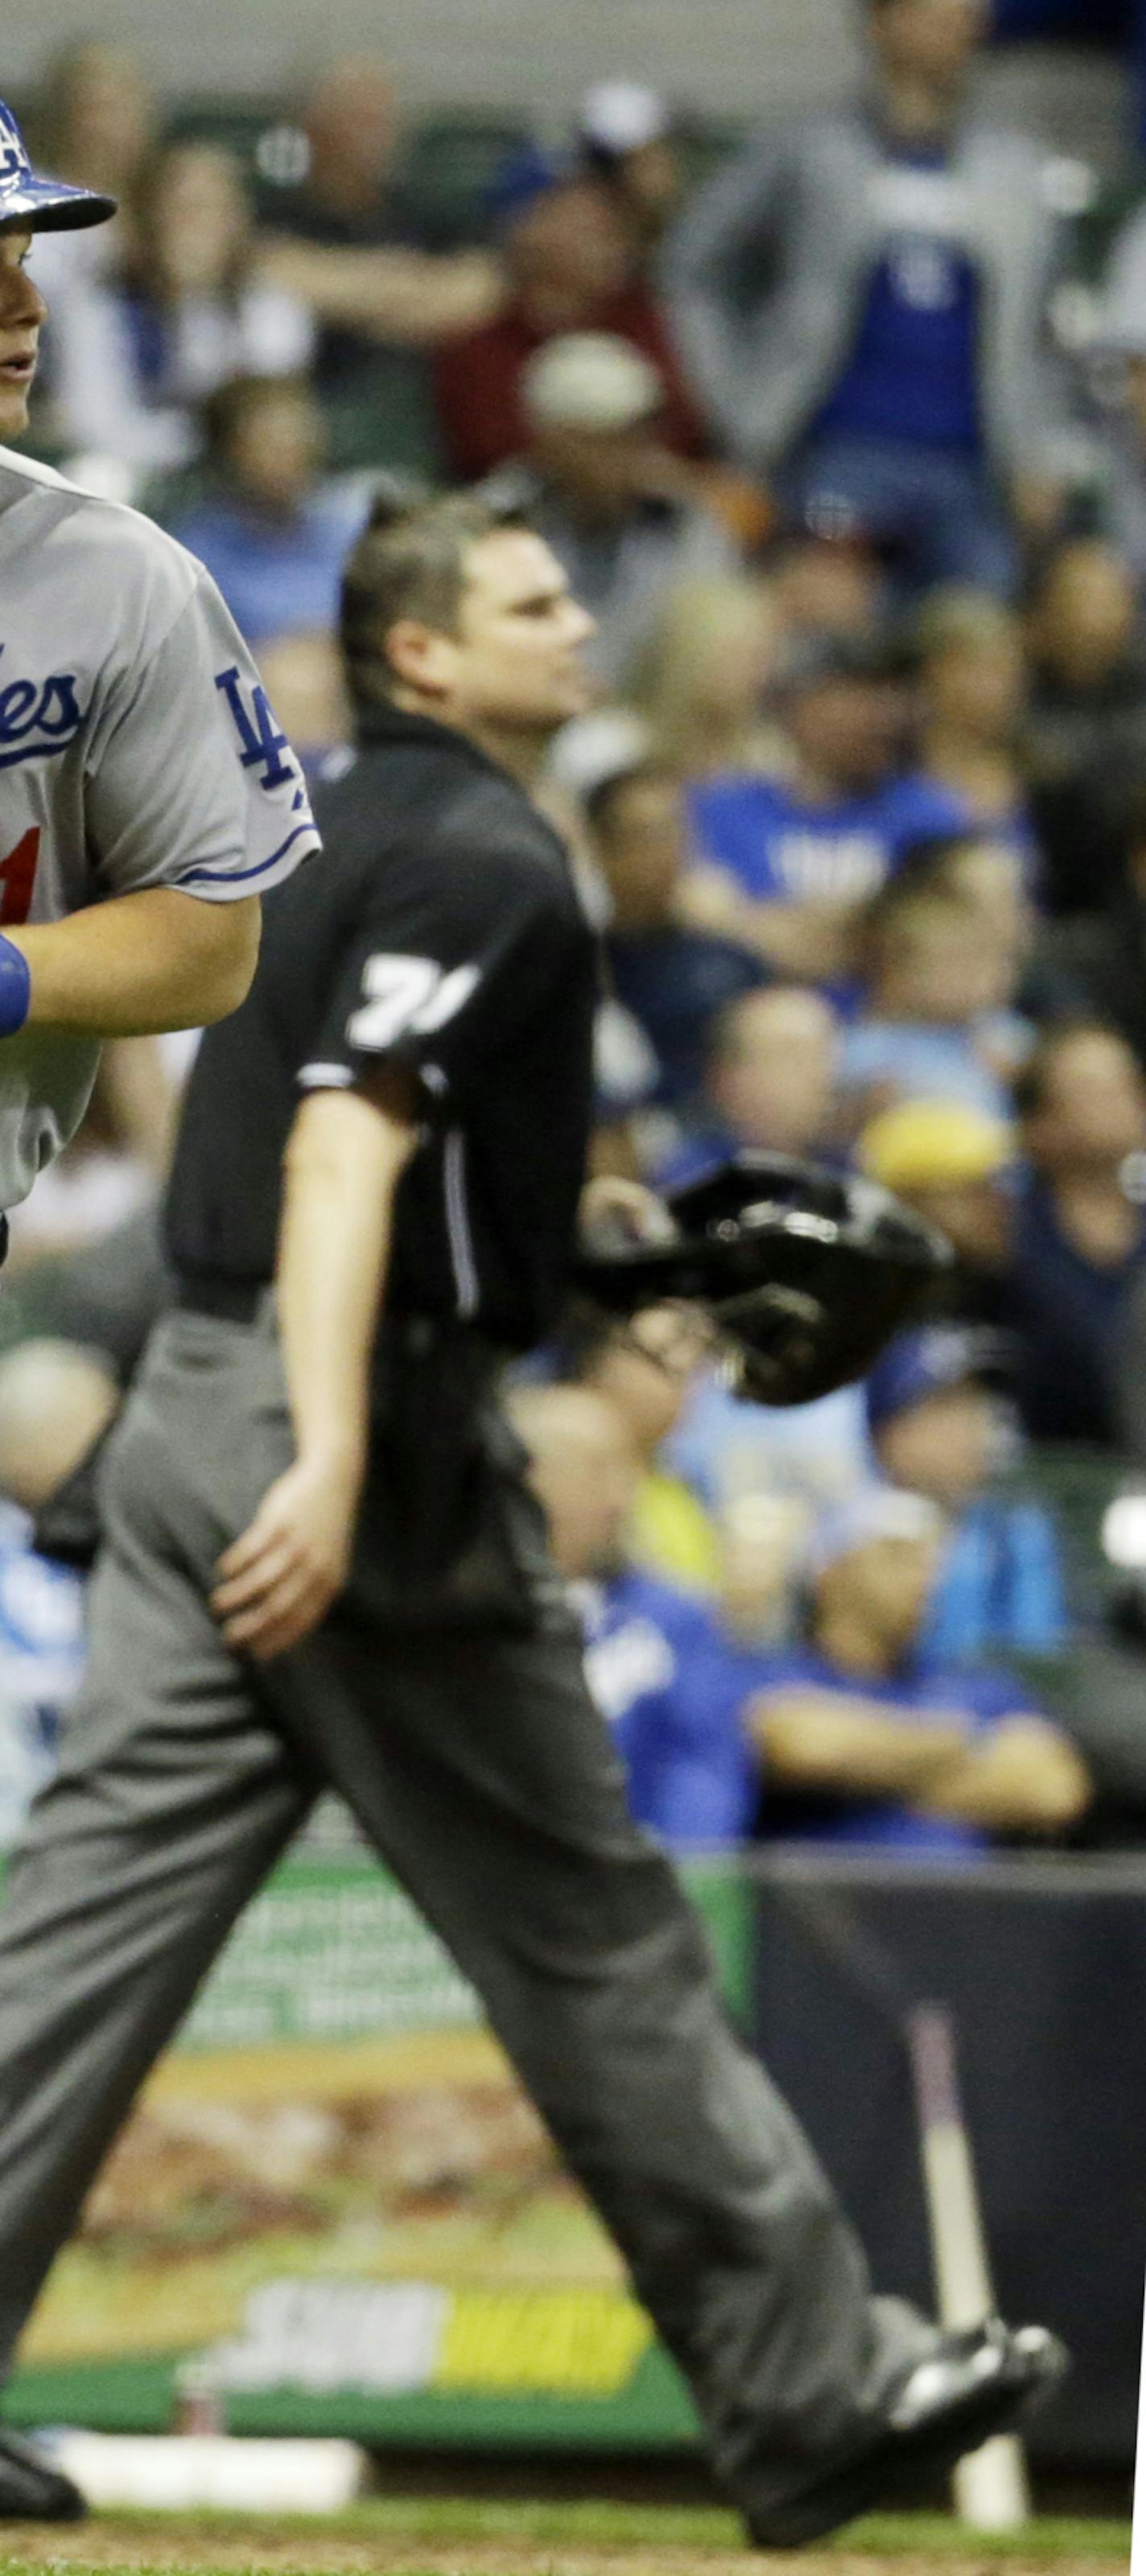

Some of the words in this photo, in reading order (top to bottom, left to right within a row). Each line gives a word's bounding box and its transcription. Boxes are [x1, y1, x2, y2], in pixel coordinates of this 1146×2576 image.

[0, 117, 27, 168] A
[0, 673, 81, 743] es
[214, 666, 295, 791] LA
